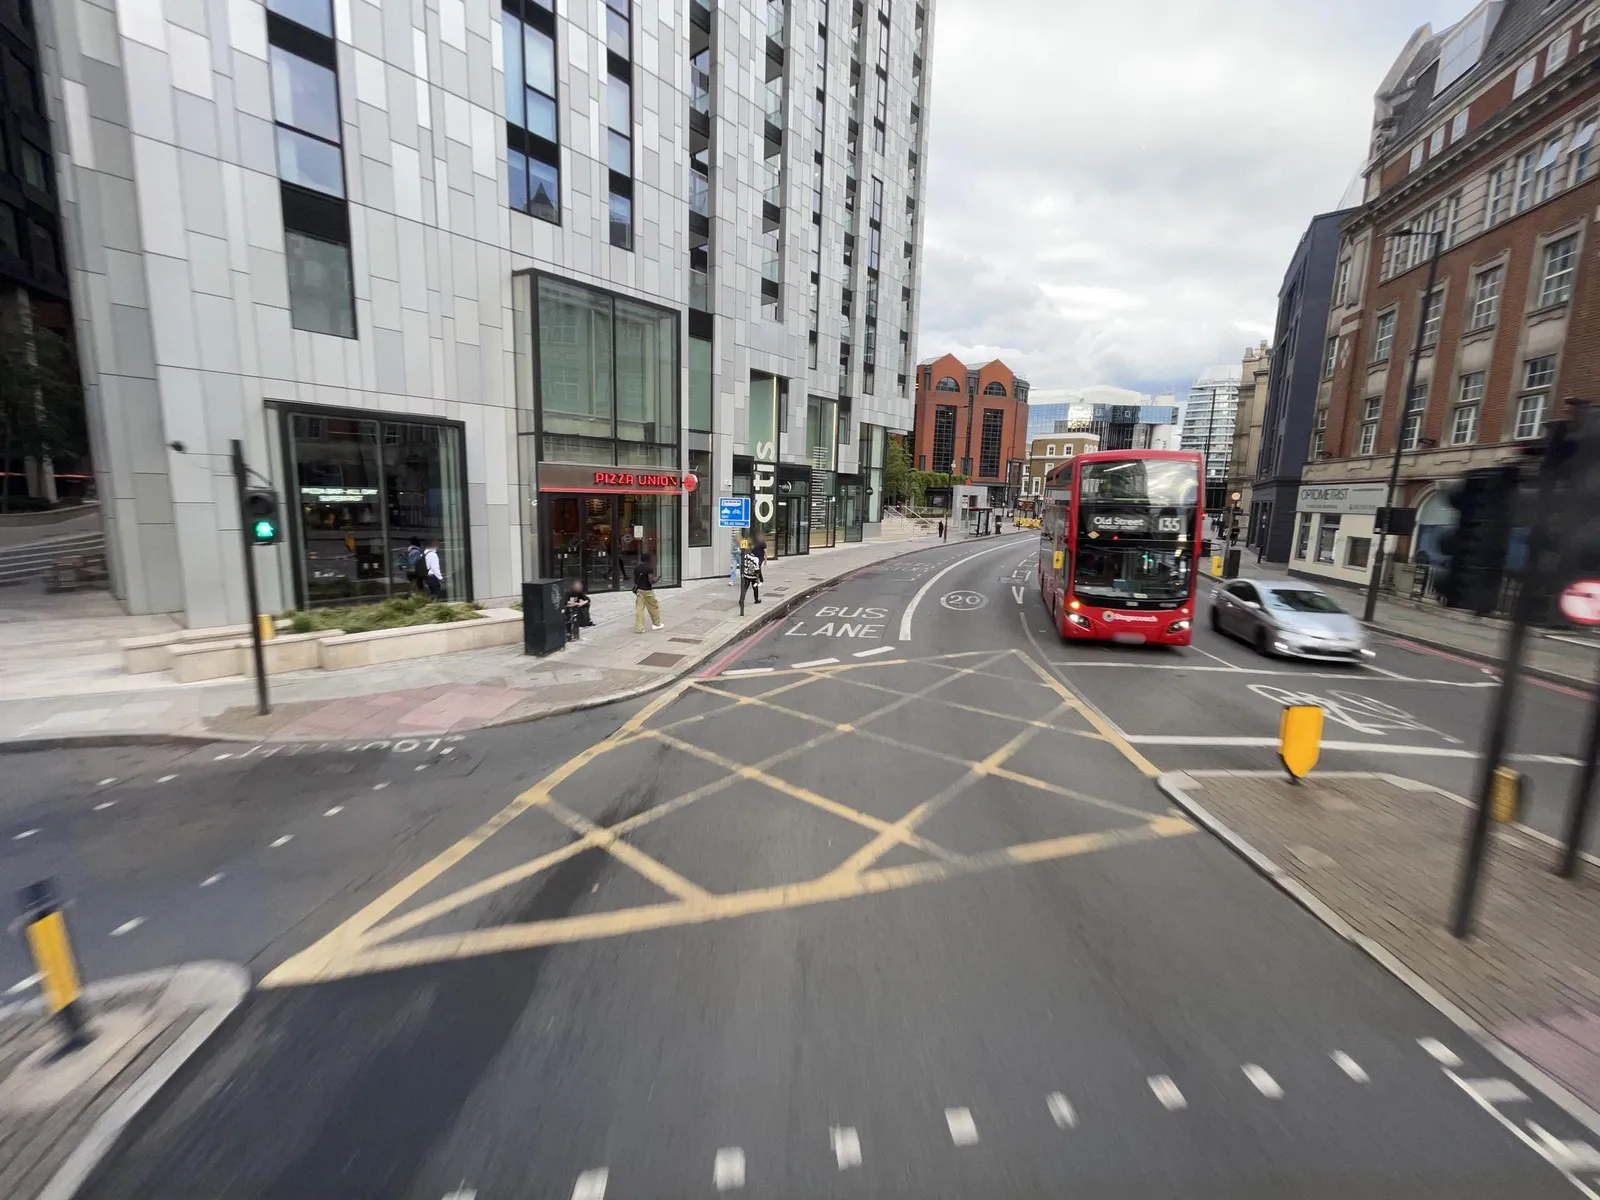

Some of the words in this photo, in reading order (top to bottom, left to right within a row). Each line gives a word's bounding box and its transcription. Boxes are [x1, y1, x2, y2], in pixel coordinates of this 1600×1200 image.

[593, 472, 634, 486] PIZZA
[753, 440, 775, 523] atis
[1301, 488, 1349, 500] OPTOMETRIST
[1093, 516, 1112, 525] Old
[1113, 517, 1145, 526] Street
[1158, 517, 1180, 531] 135
[948, 594, 980, 605] 20
[815, 606, 889, 619] BUS
[785, 622, 885, 639] LANE
